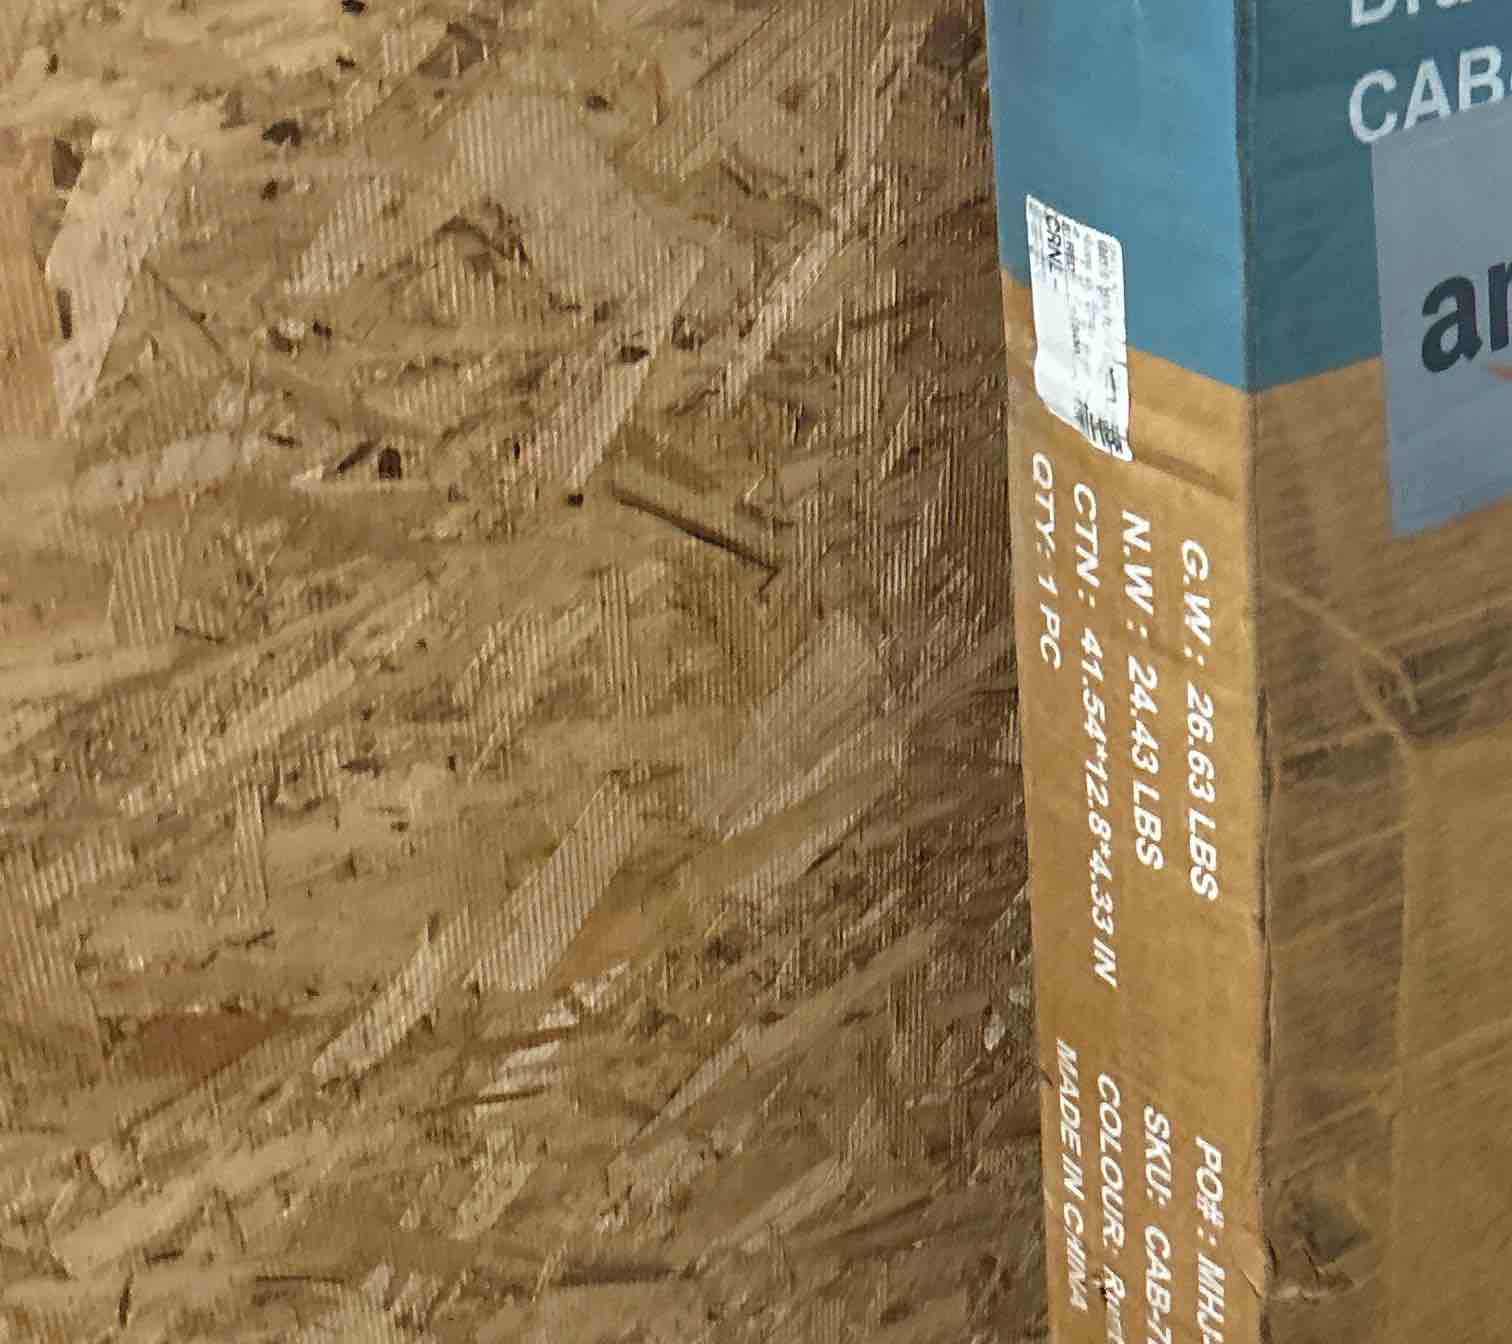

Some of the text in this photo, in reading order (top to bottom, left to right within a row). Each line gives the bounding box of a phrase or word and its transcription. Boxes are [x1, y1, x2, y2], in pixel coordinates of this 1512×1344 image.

[1039, 576, 1058, 596] 1
[1040, 602, 1061, 669] PC
[1127, 656, 1161, 774] 24.43
[1187, 682, 1215, 803] 26.63
[1134, 781, 1164, 870] LBS
[1189, 808, 1219, 901] LBS
[1094, 937, 1116, 987] IN
[1057, 1039, 1088, 1311] MADE IN CHINA
[1098, 1073, 1125, 1254] COLOUR:
[1144, 1106, 1172, 1206] SKU:
